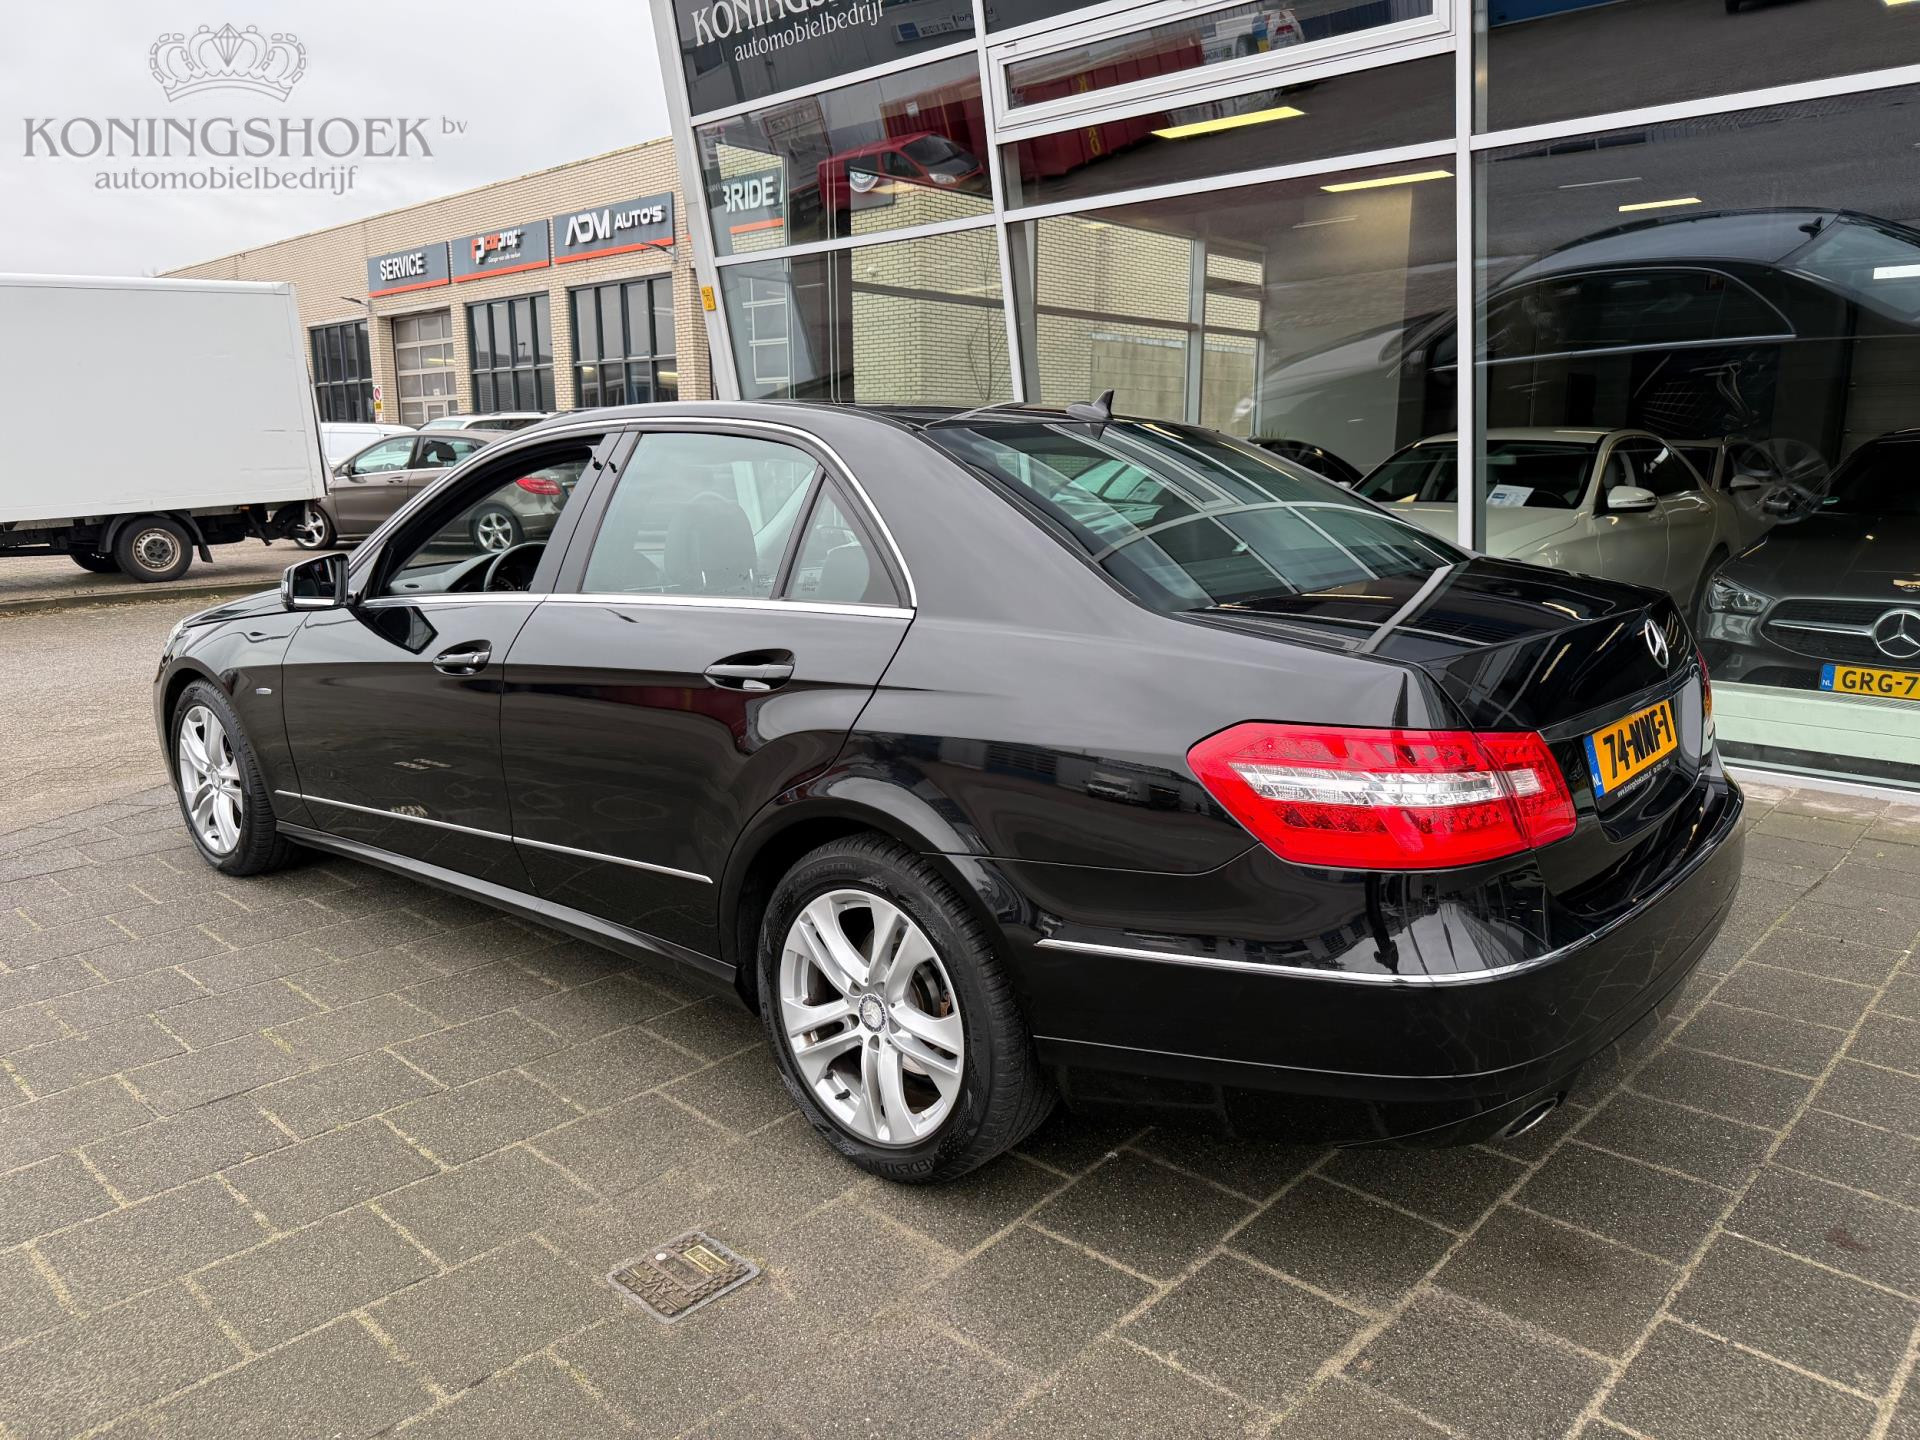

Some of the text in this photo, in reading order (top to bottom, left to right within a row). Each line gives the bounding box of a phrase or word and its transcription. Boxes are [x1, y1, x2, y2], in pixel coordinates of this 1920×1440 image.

[615, 205, 662, 230] AUTO'S
[380, 252, 424, 281] SERVICE
[1841, 670, 1920, 696] GRG-7
[1603, 705, 1672, 780] 74-NNF-1
